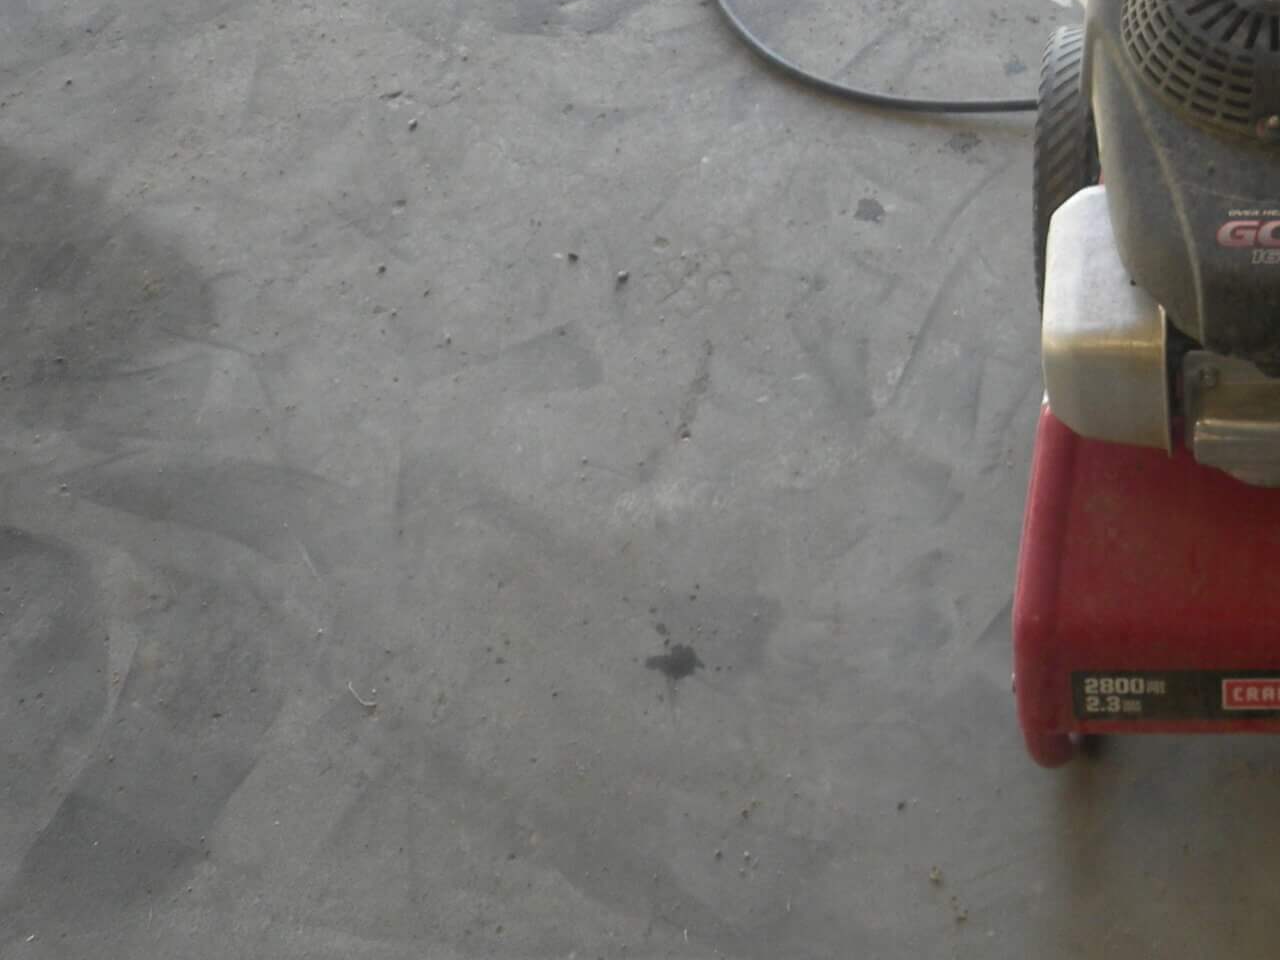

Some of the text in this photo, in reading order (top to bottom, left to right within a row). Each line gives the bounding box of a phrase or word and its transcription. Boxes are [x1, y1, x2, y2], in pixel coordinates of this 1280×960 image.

[1228, 209, 1261, 217] OVER
[1084, 677, 1145, 695] 2800
[1085, 695, 1121, 713] 2.3
